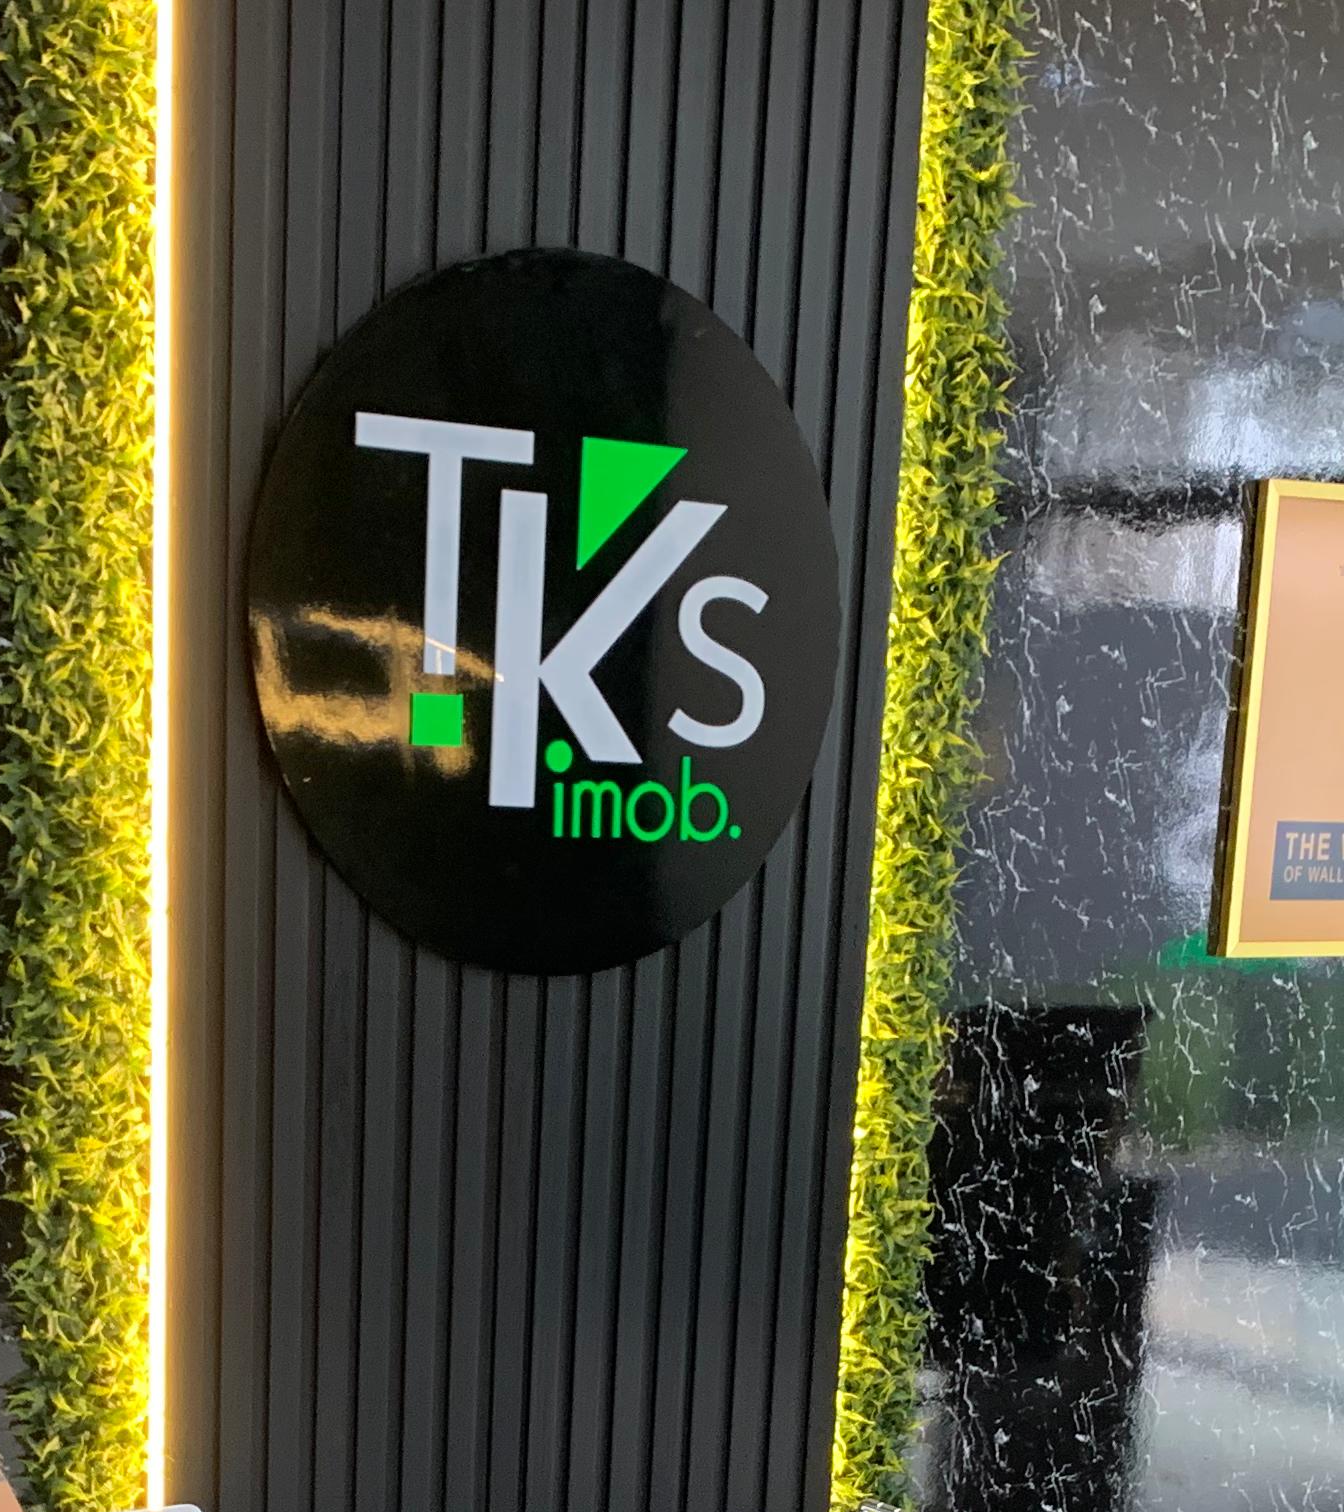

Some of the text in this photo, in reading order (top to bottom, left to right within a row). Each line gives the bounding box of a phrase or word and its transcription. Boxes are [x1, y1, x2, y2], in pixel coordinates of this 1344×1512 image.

[545, 740, 741, 841] imob.
[1285, 832, 1331, 861] THE
[1283, 865, 1303, 883] OF
[1307, 866, 1344, 884] WALL
